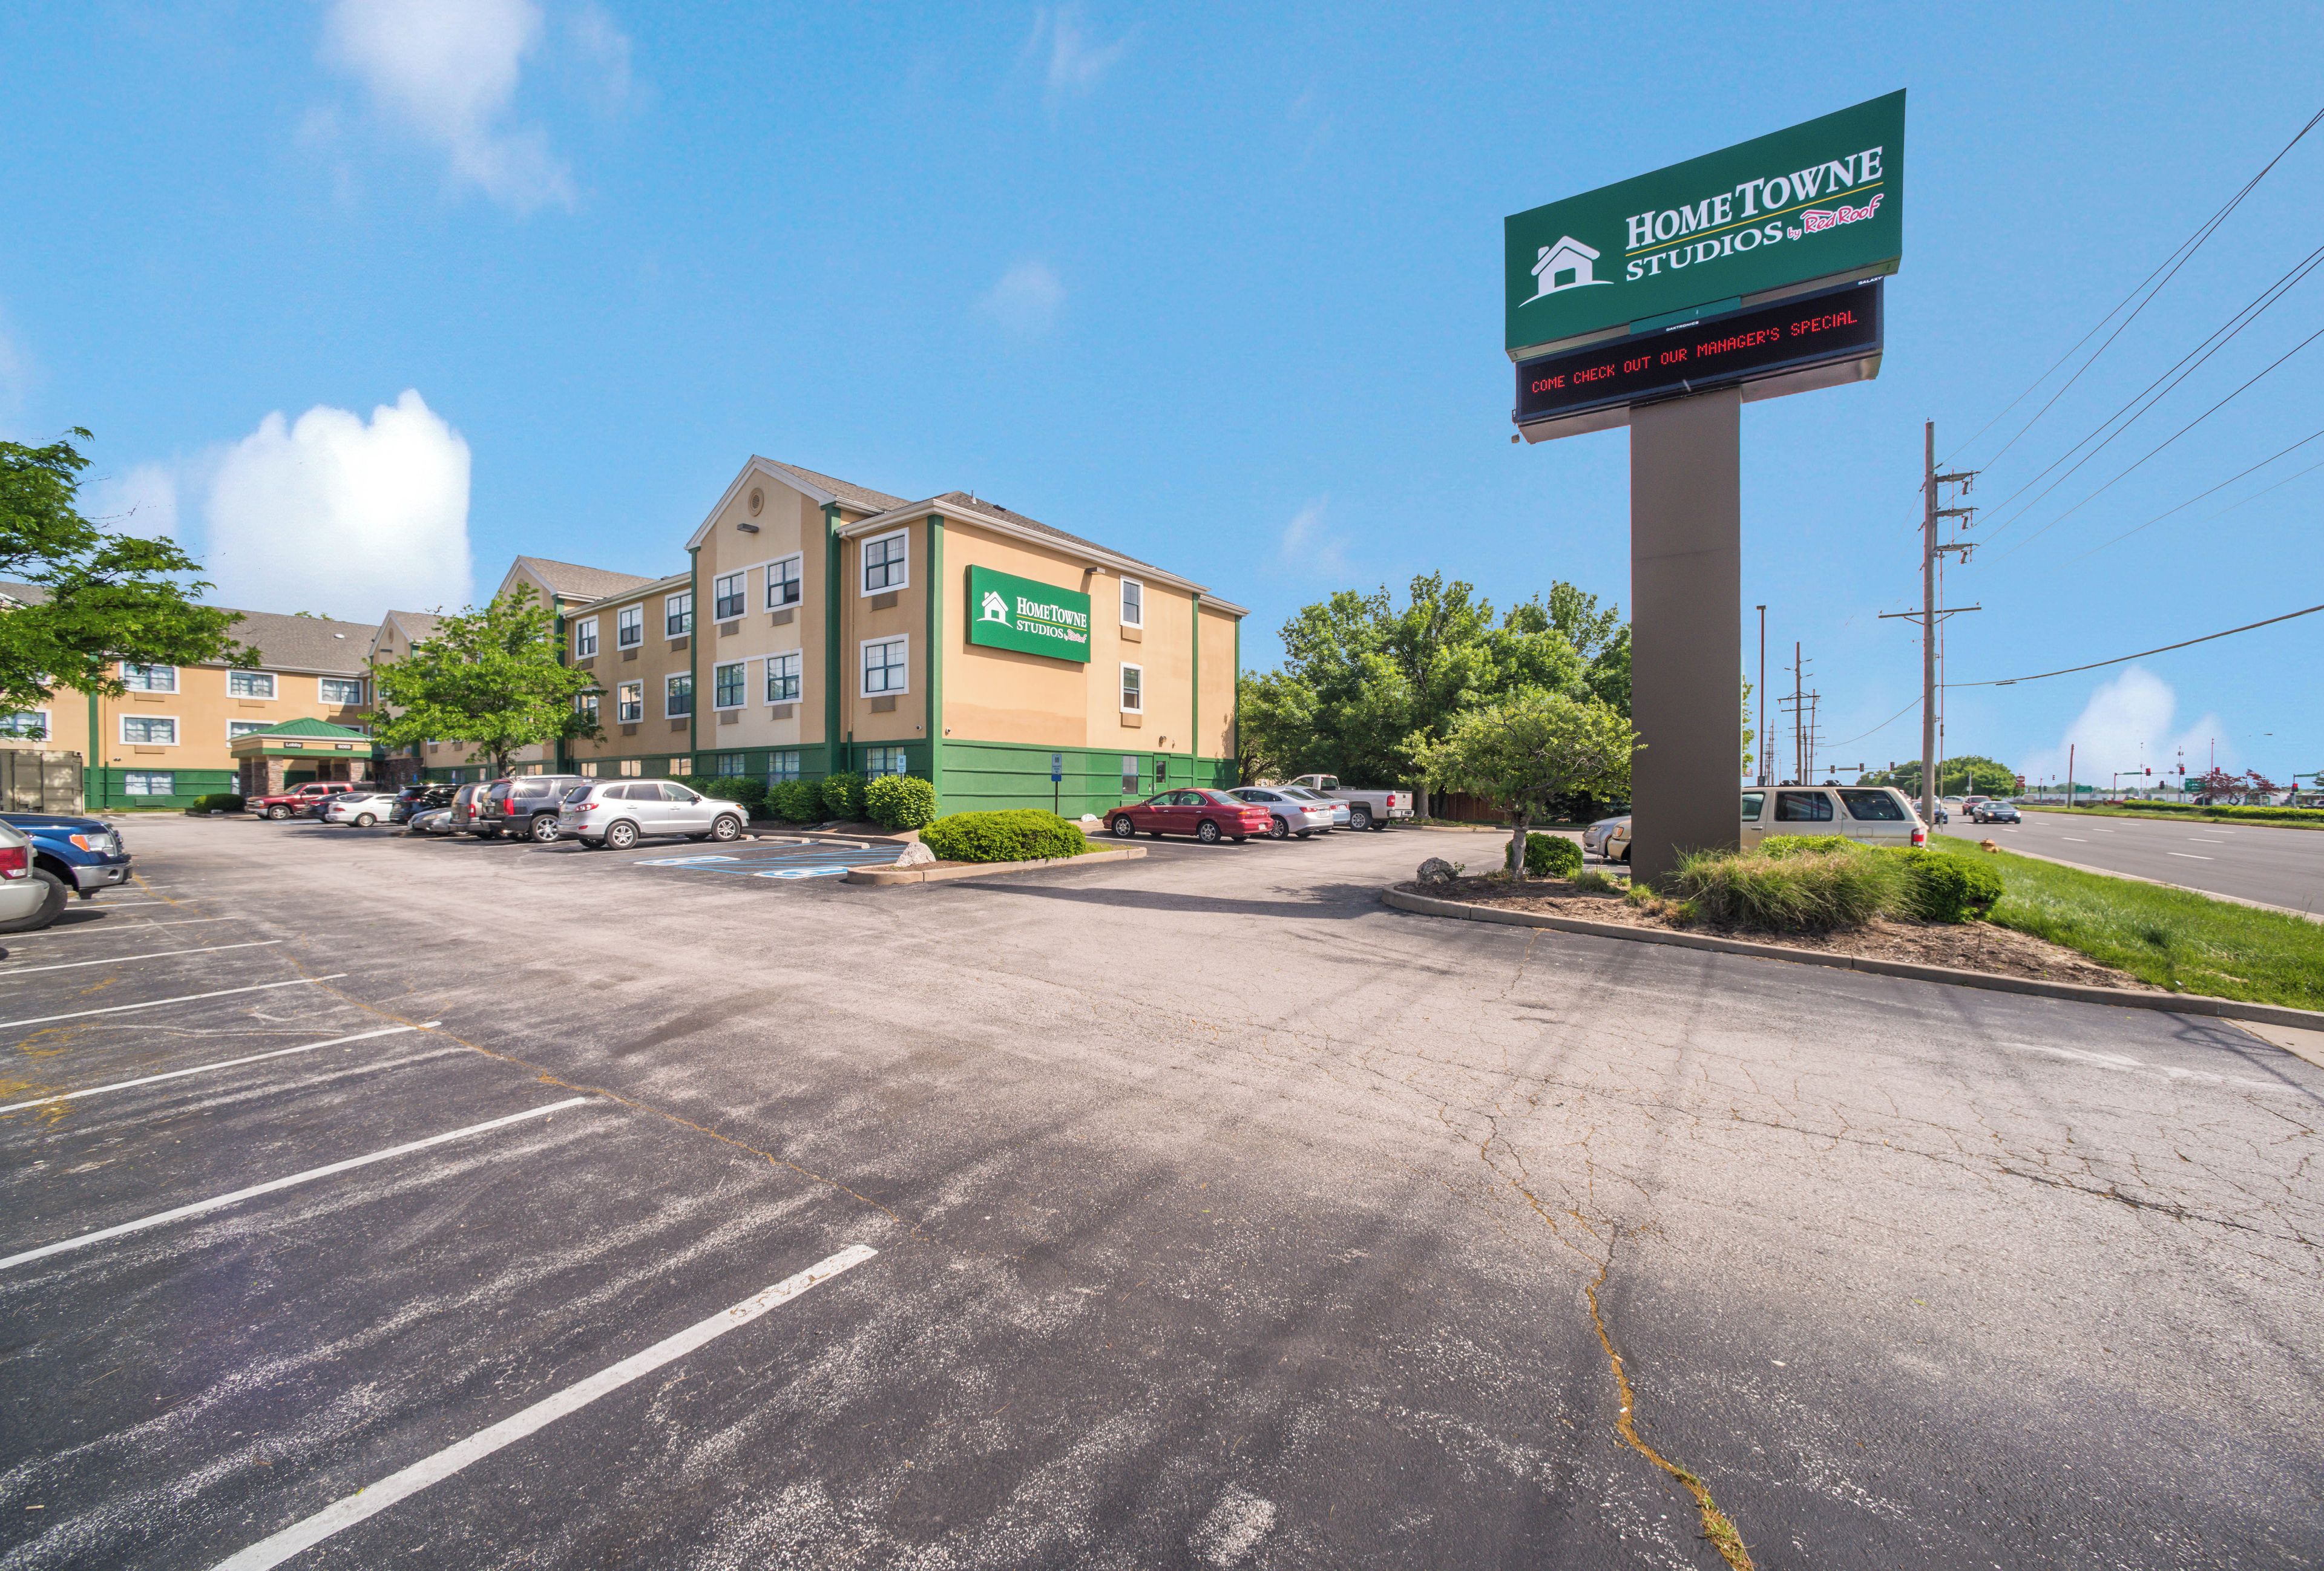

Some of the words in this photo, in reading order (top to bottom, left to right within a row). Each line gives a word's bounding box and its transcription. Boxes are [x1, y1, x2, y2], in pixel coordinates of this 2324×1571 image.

[1626, 221, 1783, 281] STUDIOS
[1787, 227, 1802, 240] by
[1858, 275, 1884, 286] GALAXY
[1666, 321, 1699, 332] DAKTRONICS
[1532, 375, 1565, 393] COME
[1573, 364, 1615, 384] CHECK
[1623, 355, 1652, 373] OUT
[1661, 348, 1687, 365] OUR
[1697, 327, 1780, 358] MANAGER'S
[1791, 310, 1858, 336] SPECIAL
[1016, 619, 1063, 638] STUDIOS
